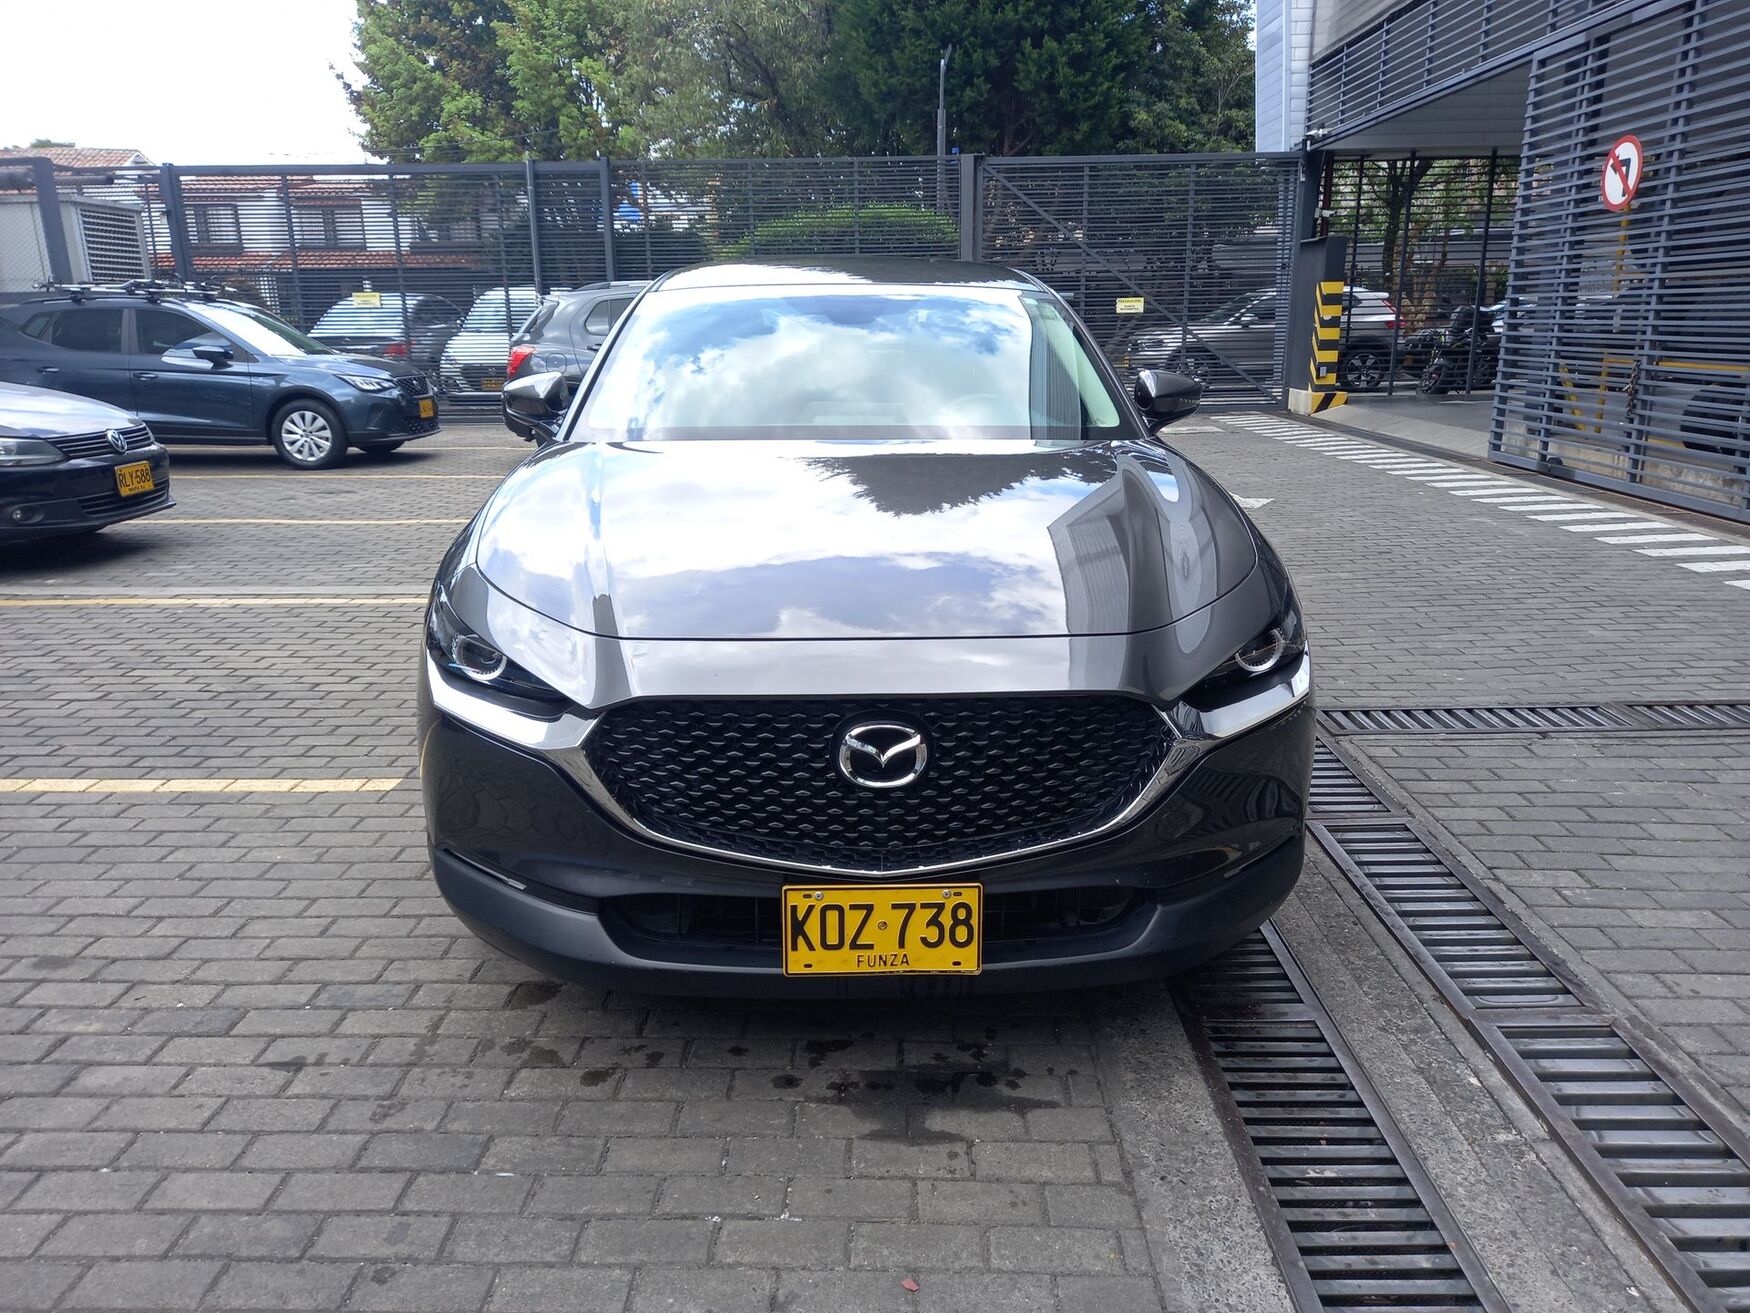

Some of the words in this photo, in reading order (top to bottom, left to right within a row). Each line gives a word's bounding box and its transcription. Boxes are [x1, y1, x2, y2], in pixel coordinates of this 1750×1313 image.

[790, 904, 874, 951] KOZ
[891, 902, 974, 949] 738
[856, 954, 910, 968] FUNZA
